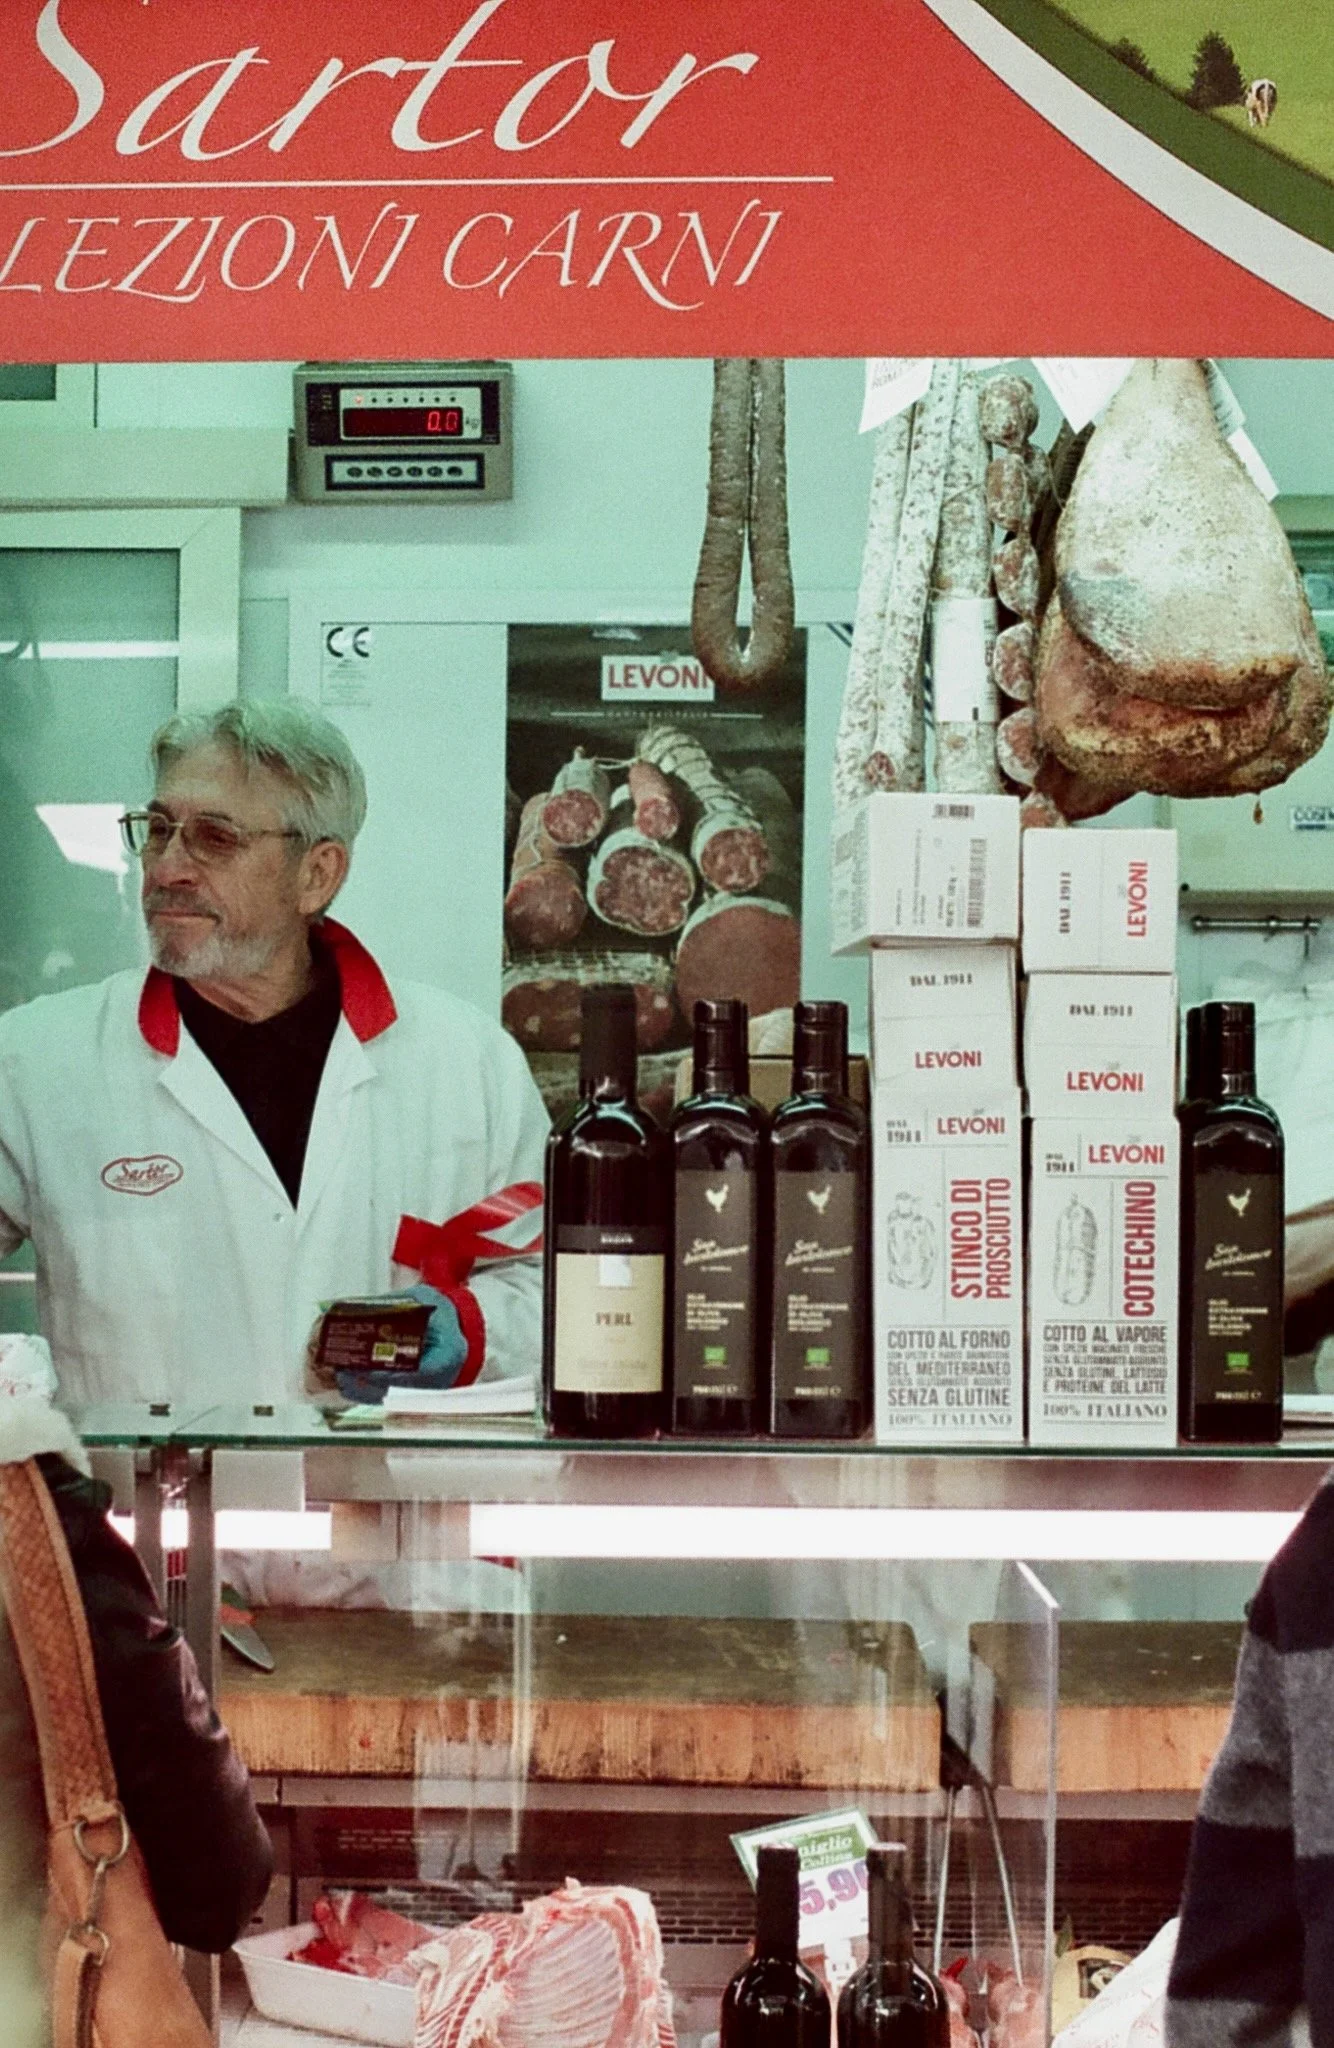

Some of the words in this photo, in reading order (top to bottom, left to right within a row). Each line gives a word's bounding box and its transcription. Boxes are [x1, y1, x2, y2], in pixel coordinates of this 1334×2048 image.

[0, 0, 759, 161] Sartor
[443, 199, 784, 311] CARNI
[326, 627, 369, 657] CE
[608, 663, 708, 689] LEVONI
[1127, 861, 1148, 937] LEVONI
[942, 973, 973, 985] 1911
[1103, 1005, 1133, 1016] 1911
[915, 1050, 982, 1069] LEVONI
[1066, 1071, 1143, 1092] LEVONI
[937, 1117, 1005, 1135] LEVONI
[886, 1130, 922, 1143] 1911
[1088, 1144, 1165, 1164] LEVONI
[951, 1179, 982, 1204] DI
[985, 1178, 1012, 1299] PROSCIUTTO
[951, 1210, 982, 1299] STINCO
[1123, 1181, 1157, 1318] COTECHINO
[888, 1330, 935, 1349] COTTO
[939, 1330, 957, 1349] AL
[960, 1330, 1010, 1349] FORNO
[1043, 1325, 1087, 1342] COTTO
[1092, 1325, 1109, 1342] AL
[1116, 1325, 1167, 1342] VAPORE
[915, 1361, 1011, 1376] MEDITERRANEO
[887, 1388, 939, 1406] SENZA
[945, 1388, 1010, 1406] GLUTINE
[1087, 1403, 1168, 1417] ITALIANO
